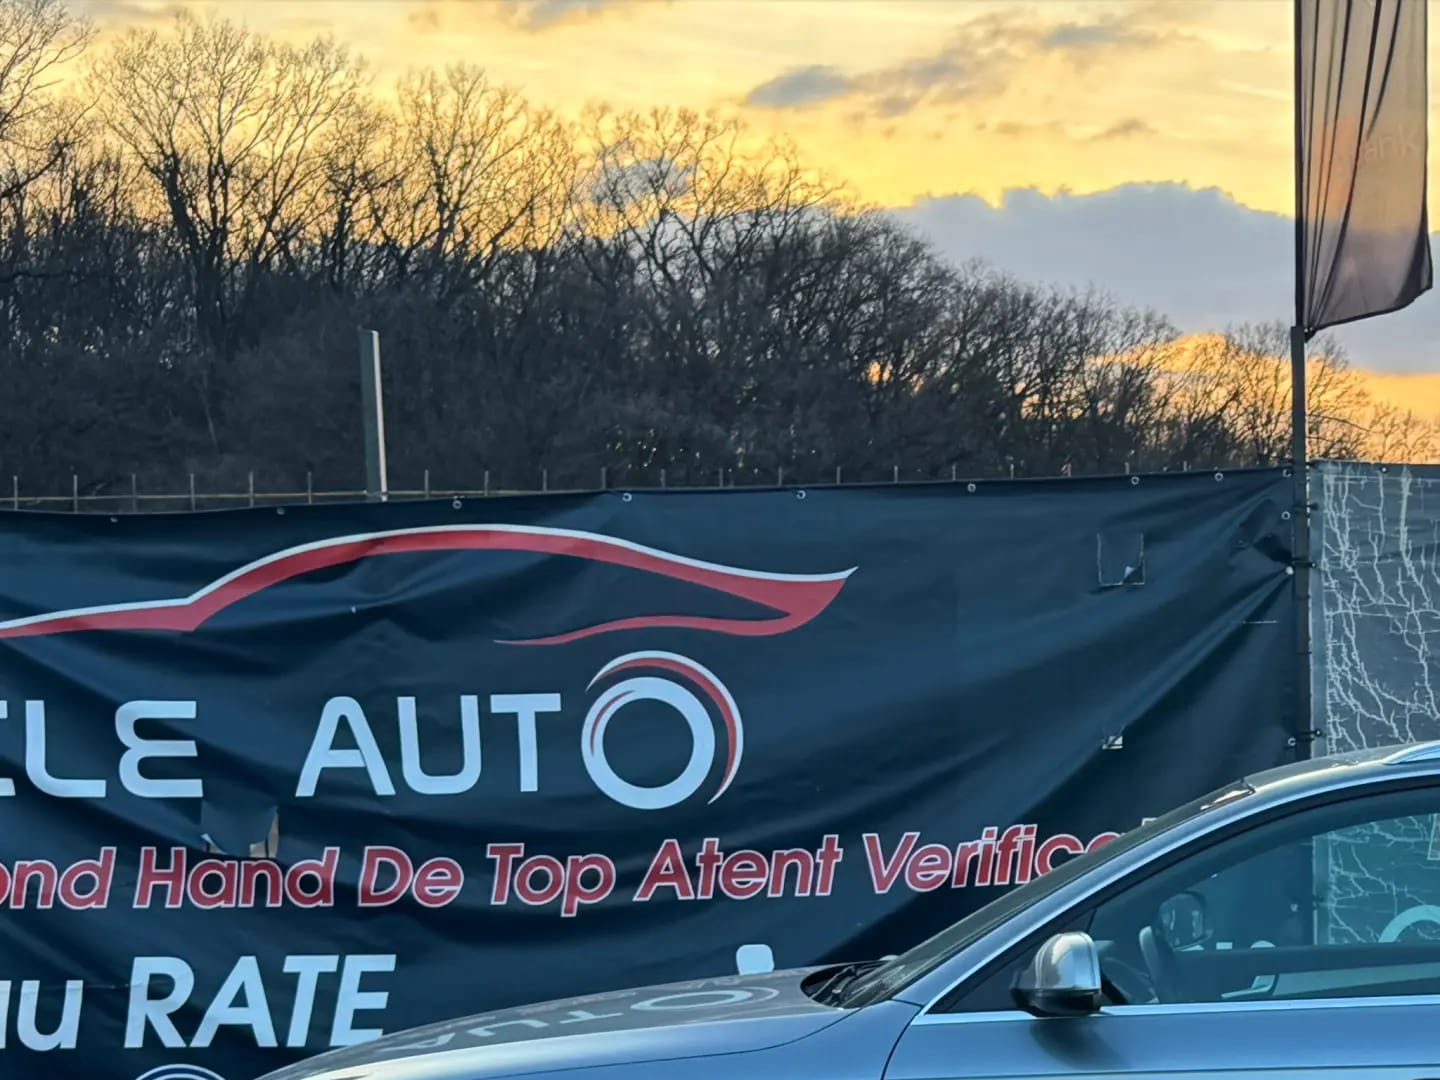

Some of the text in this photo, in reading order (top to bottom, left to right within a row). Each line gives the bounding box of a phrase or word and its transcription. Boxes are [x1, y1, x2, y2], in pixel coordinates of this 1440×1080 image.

[0, 677, 717, 810] LE AUTO
[0, 822, 1158, 917] nd Hand De Top Atent Verific
[0, 954, 397, 1051] u RATE
